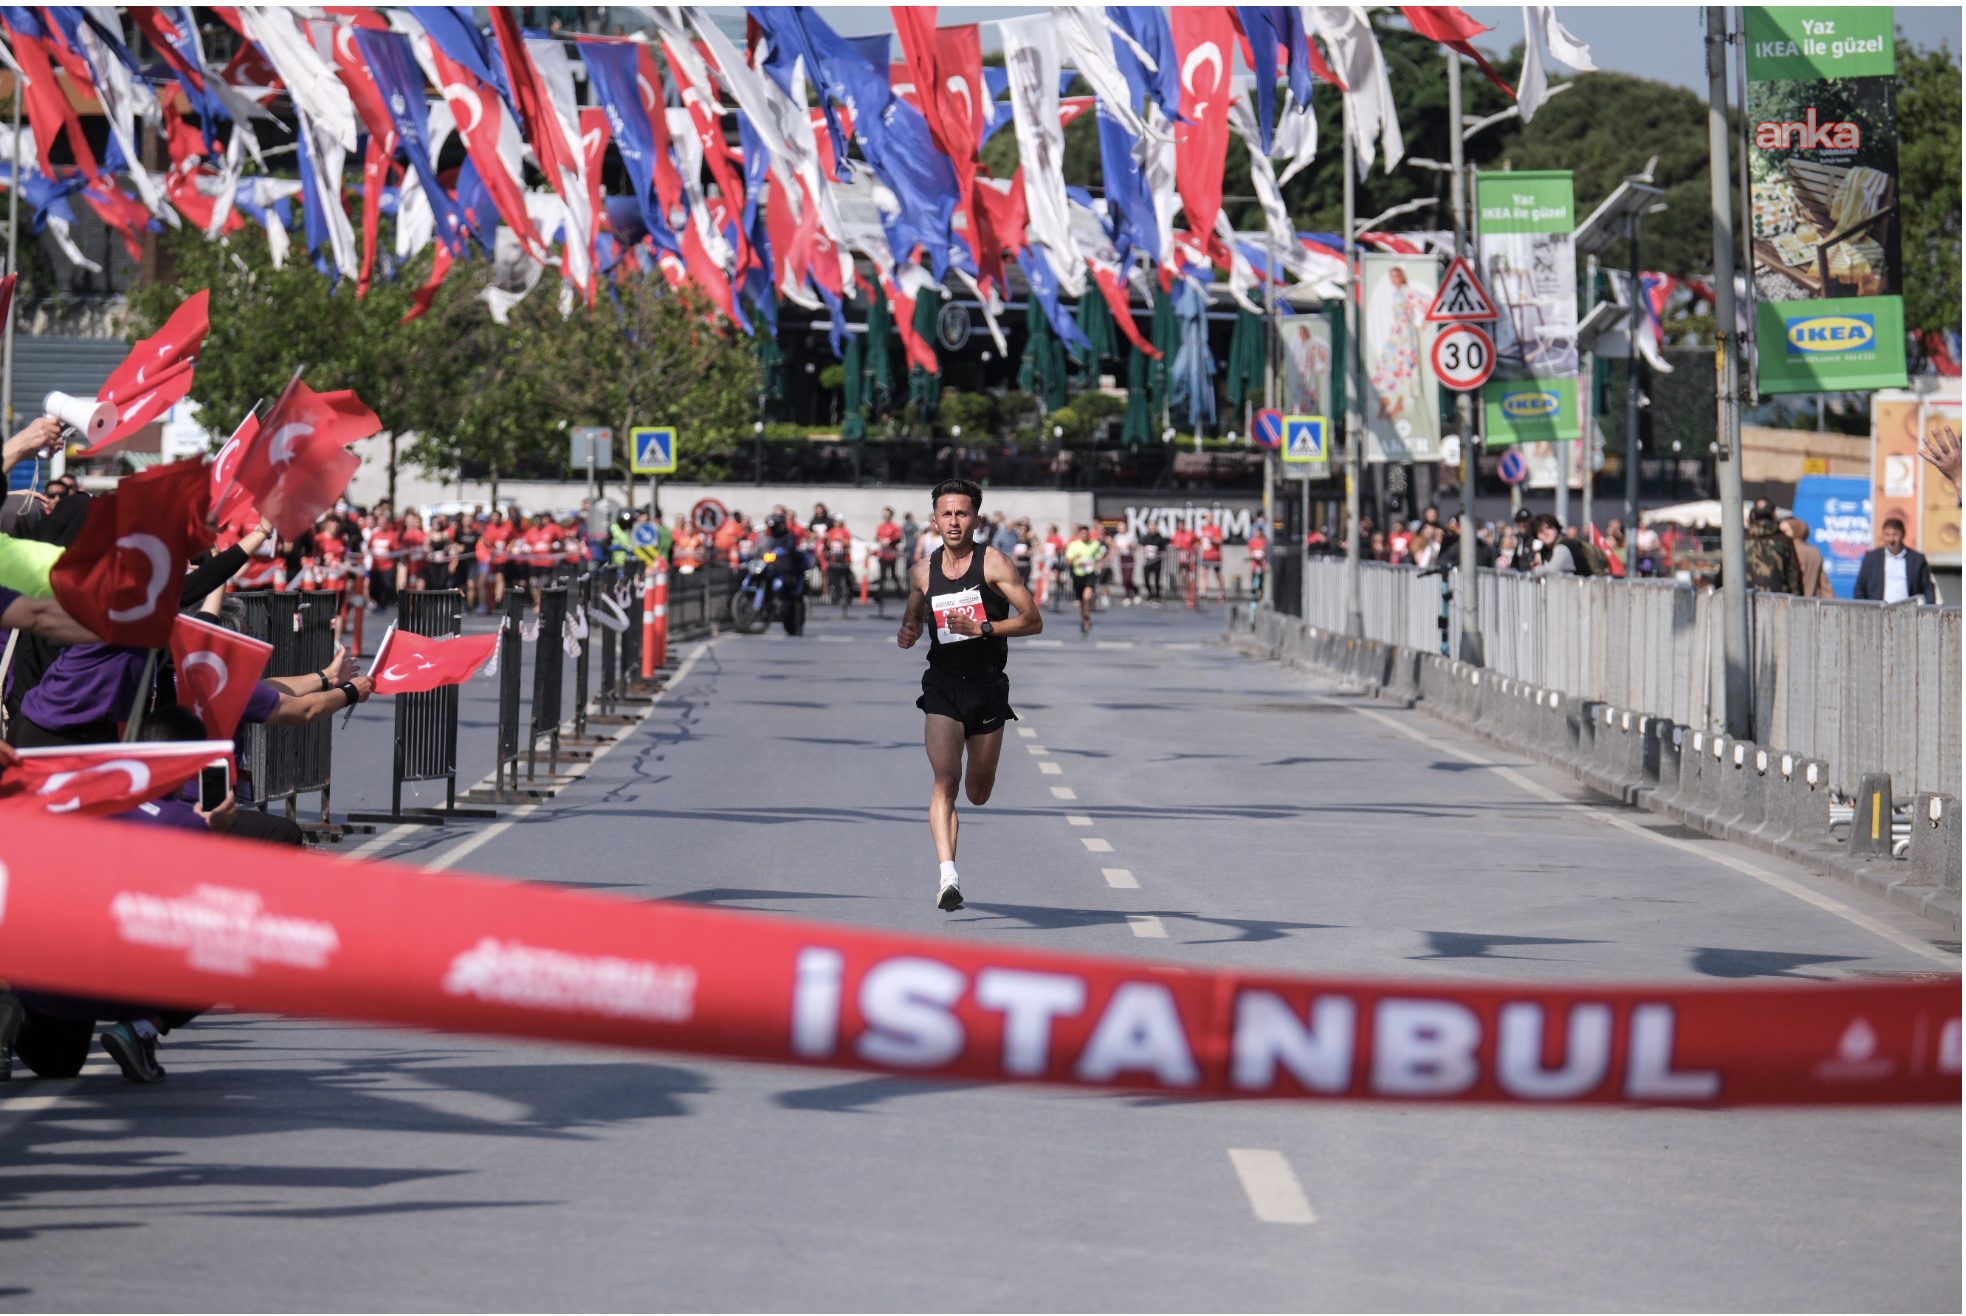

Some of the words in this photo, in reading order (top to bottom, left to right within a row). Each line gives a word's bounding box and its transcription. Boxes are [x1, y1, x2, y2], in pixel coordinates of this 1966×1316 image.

[1801, 19, 1835, 35] Yaz
[1755, 40, 1799, 58] IKEA
[1803, 38, 1827, 56] ile
[1831, 35, 1883, 59] güzel
[1512, 193, 1535, 205] Yaz
[1482, 207, 1511, 219] IKEA
[1513, 206, 1530, 219] ile
[1531, 205, 1566, 222] güzel
[1796, 325, 1866, 342] IKEA
[1445, 343, 1482, 370] 30
[1507, 398, 1553, 409] IKEA
[791, 945, 1720, 1100] İSTANBUL
